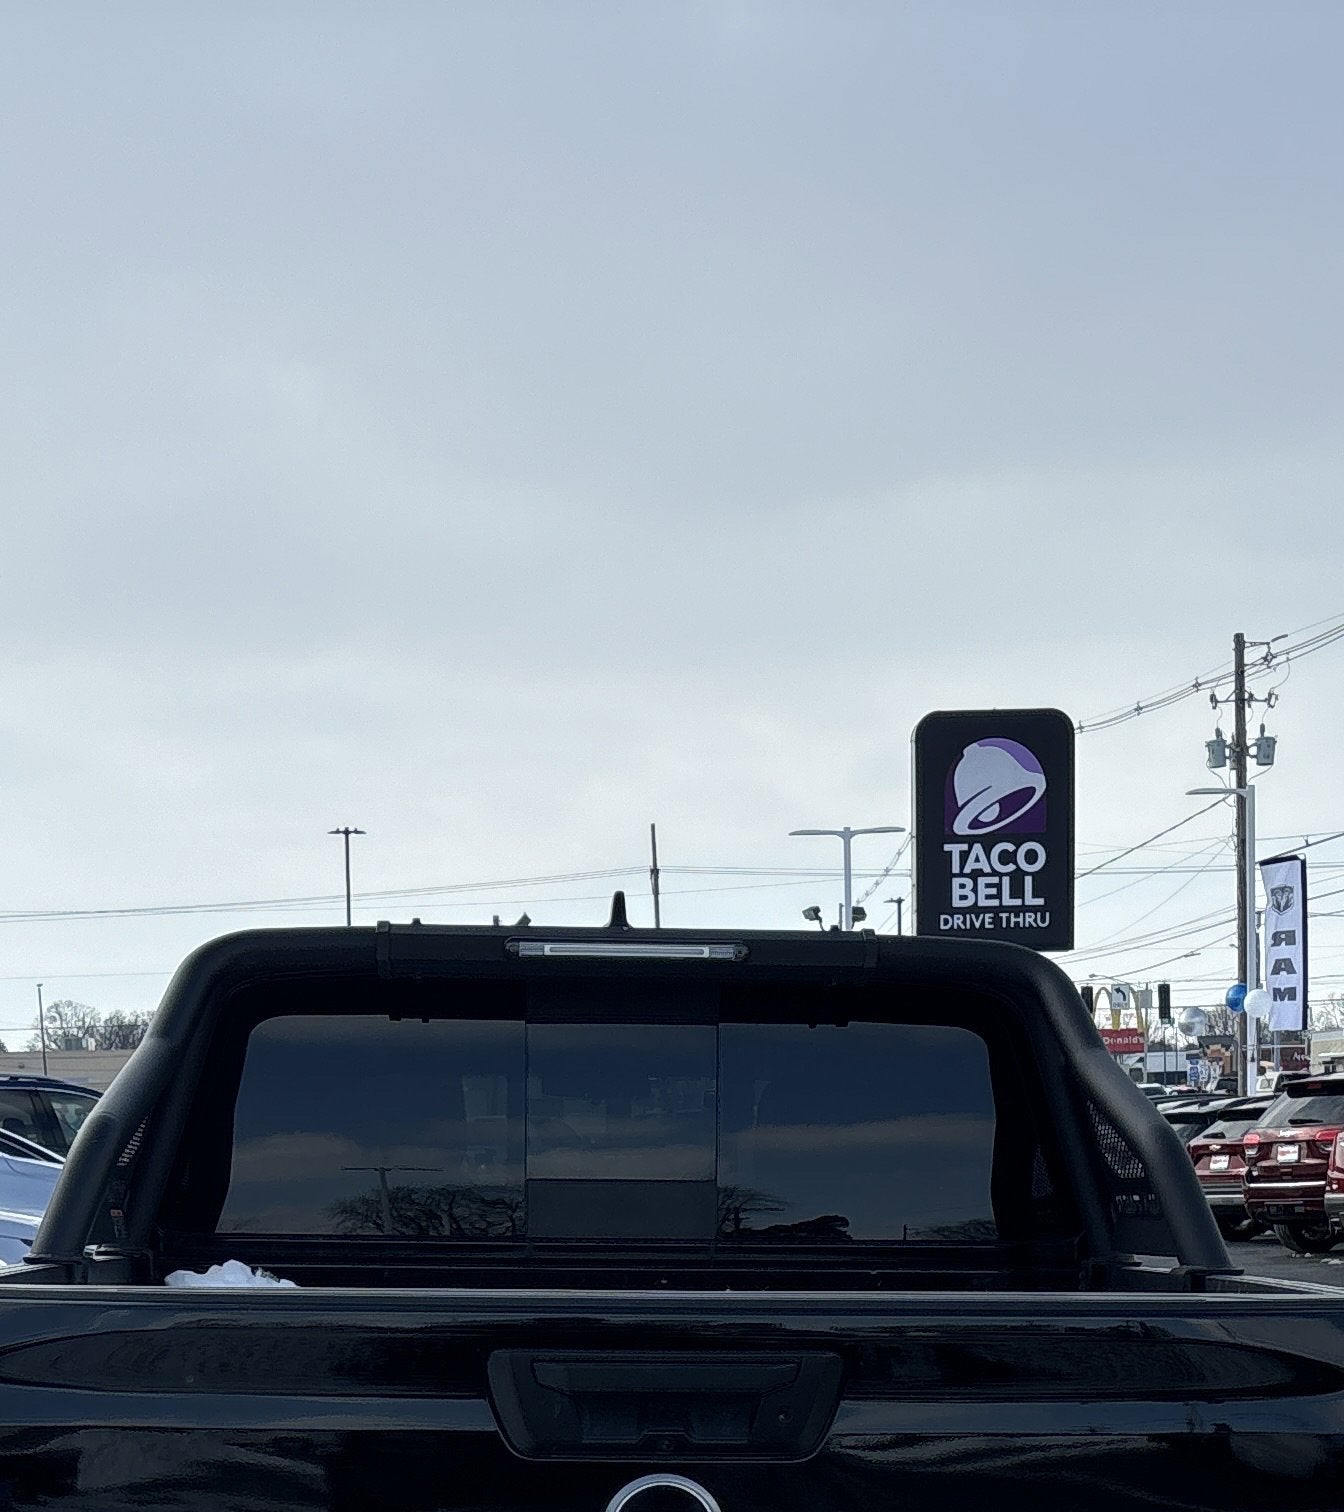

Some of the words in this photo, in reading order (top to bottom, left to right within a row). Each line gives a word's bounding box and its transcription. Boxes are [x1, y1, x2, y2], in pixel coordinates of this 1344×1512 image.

[943, 842, 1046, 873] TACO
[951, 876, 1045, 908] BELL
[939, 912, 995, 931] DRIVE
[999, 911, 1050, 930] THRU
